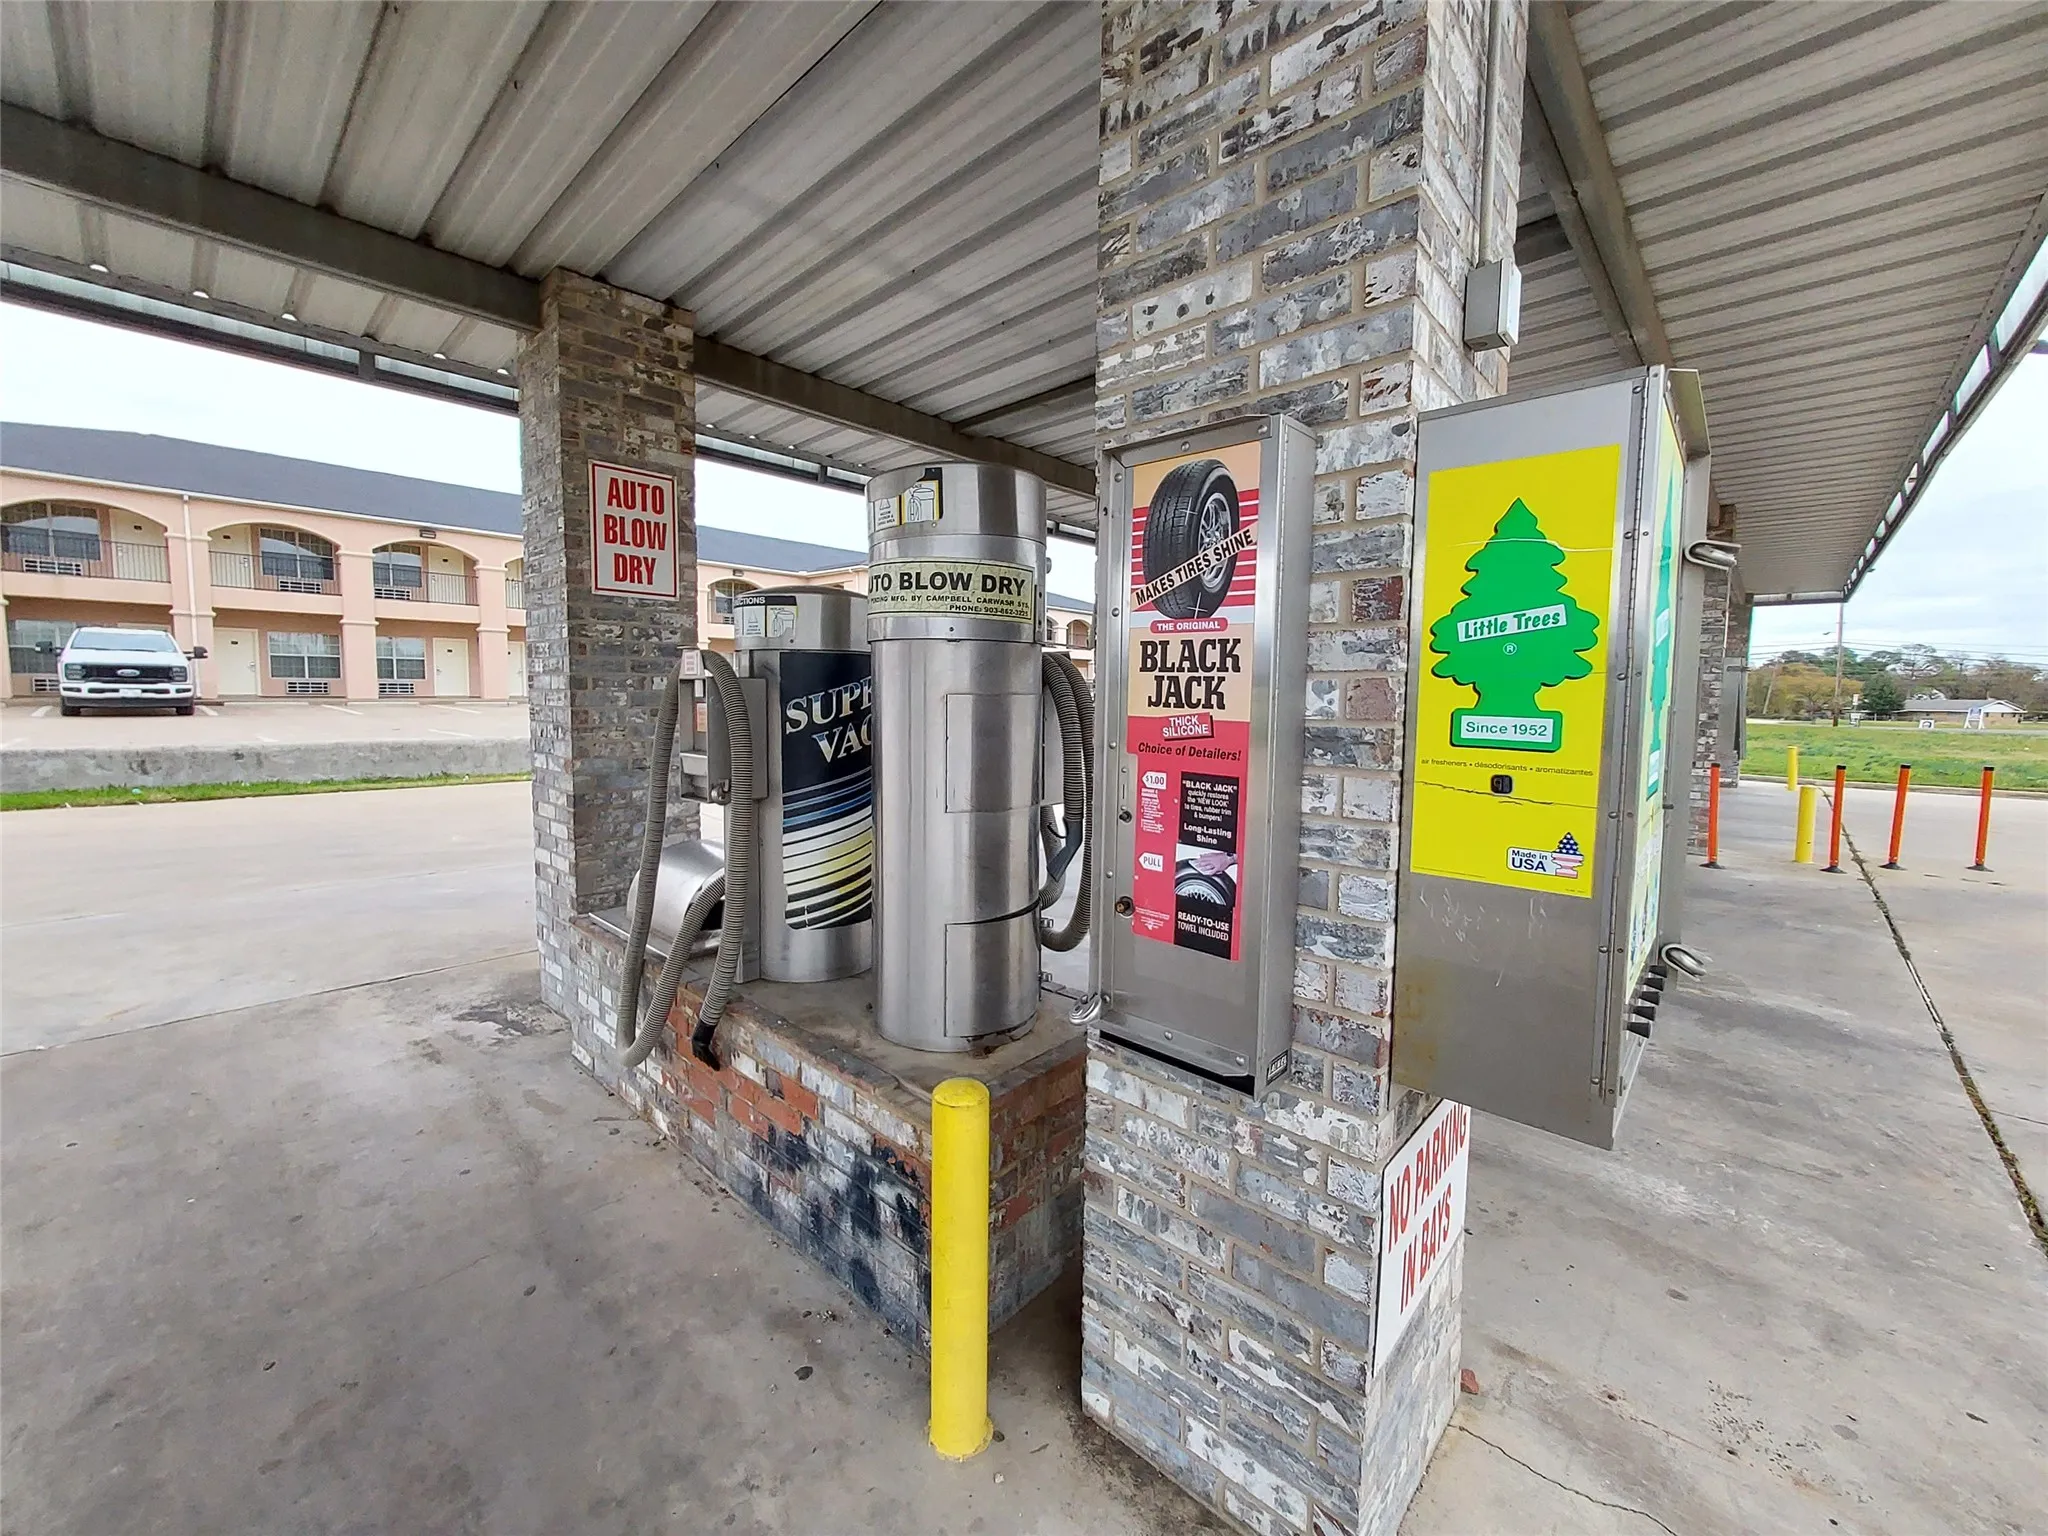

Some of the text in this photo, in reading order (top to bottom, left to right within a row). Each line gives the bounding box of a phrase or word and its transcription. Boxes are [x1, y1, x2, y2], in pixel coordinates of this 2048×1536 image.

[607, 477, 665, 515] AUTO
[603, 513, 667, 551] BLOW
[614, 553, 656, 585] DRY
[1136, 529, 1253, 605] MAKES TIRES SHINE
[900, 572, 972, 591] BLOW
[981, 574, 1025, 596] DRY
[976, 597, 1014, 606] CARWASH
[1157, 621, 1220, 631] THE ORIGINAL
[1464, 612, 1560, 639] Little Trees
[1139, 638, 1241, 673] BLACK
[1148, 675, 1225, 710] JACK
[1169, 715, 1199, 726] THICK
[1465, 721, 1548, 736] Since 1952
[1162, 724, 1209, 737] SILICONE
[1138, 742, 1242, 761] Choice of Detailers!
[1431, 758, 1467, 768] fresheners
[1535, 767, 1594, 777] aromatizantes
[1145, 775, 1165, 785] $1.00
[1204, 806, 1221, 814] rubber
[1183, 822, 1232, 839] Long-Lasting
[1196, 834, 1218, 845] Shine
[1143, 856, 1161, 868] PULL
[1511, 849, 1537, 860] Made
[1511, 857, 1547, 873] USA
[1177, 911, 1229, 931] READY-TO-USE
[1177, 921, 1229, 941] TOWEL INCLUDED
[1388, 1103, 1467, 1253] NO PARKING
[1400, 1182, 1452, 1315] IN BAYS
